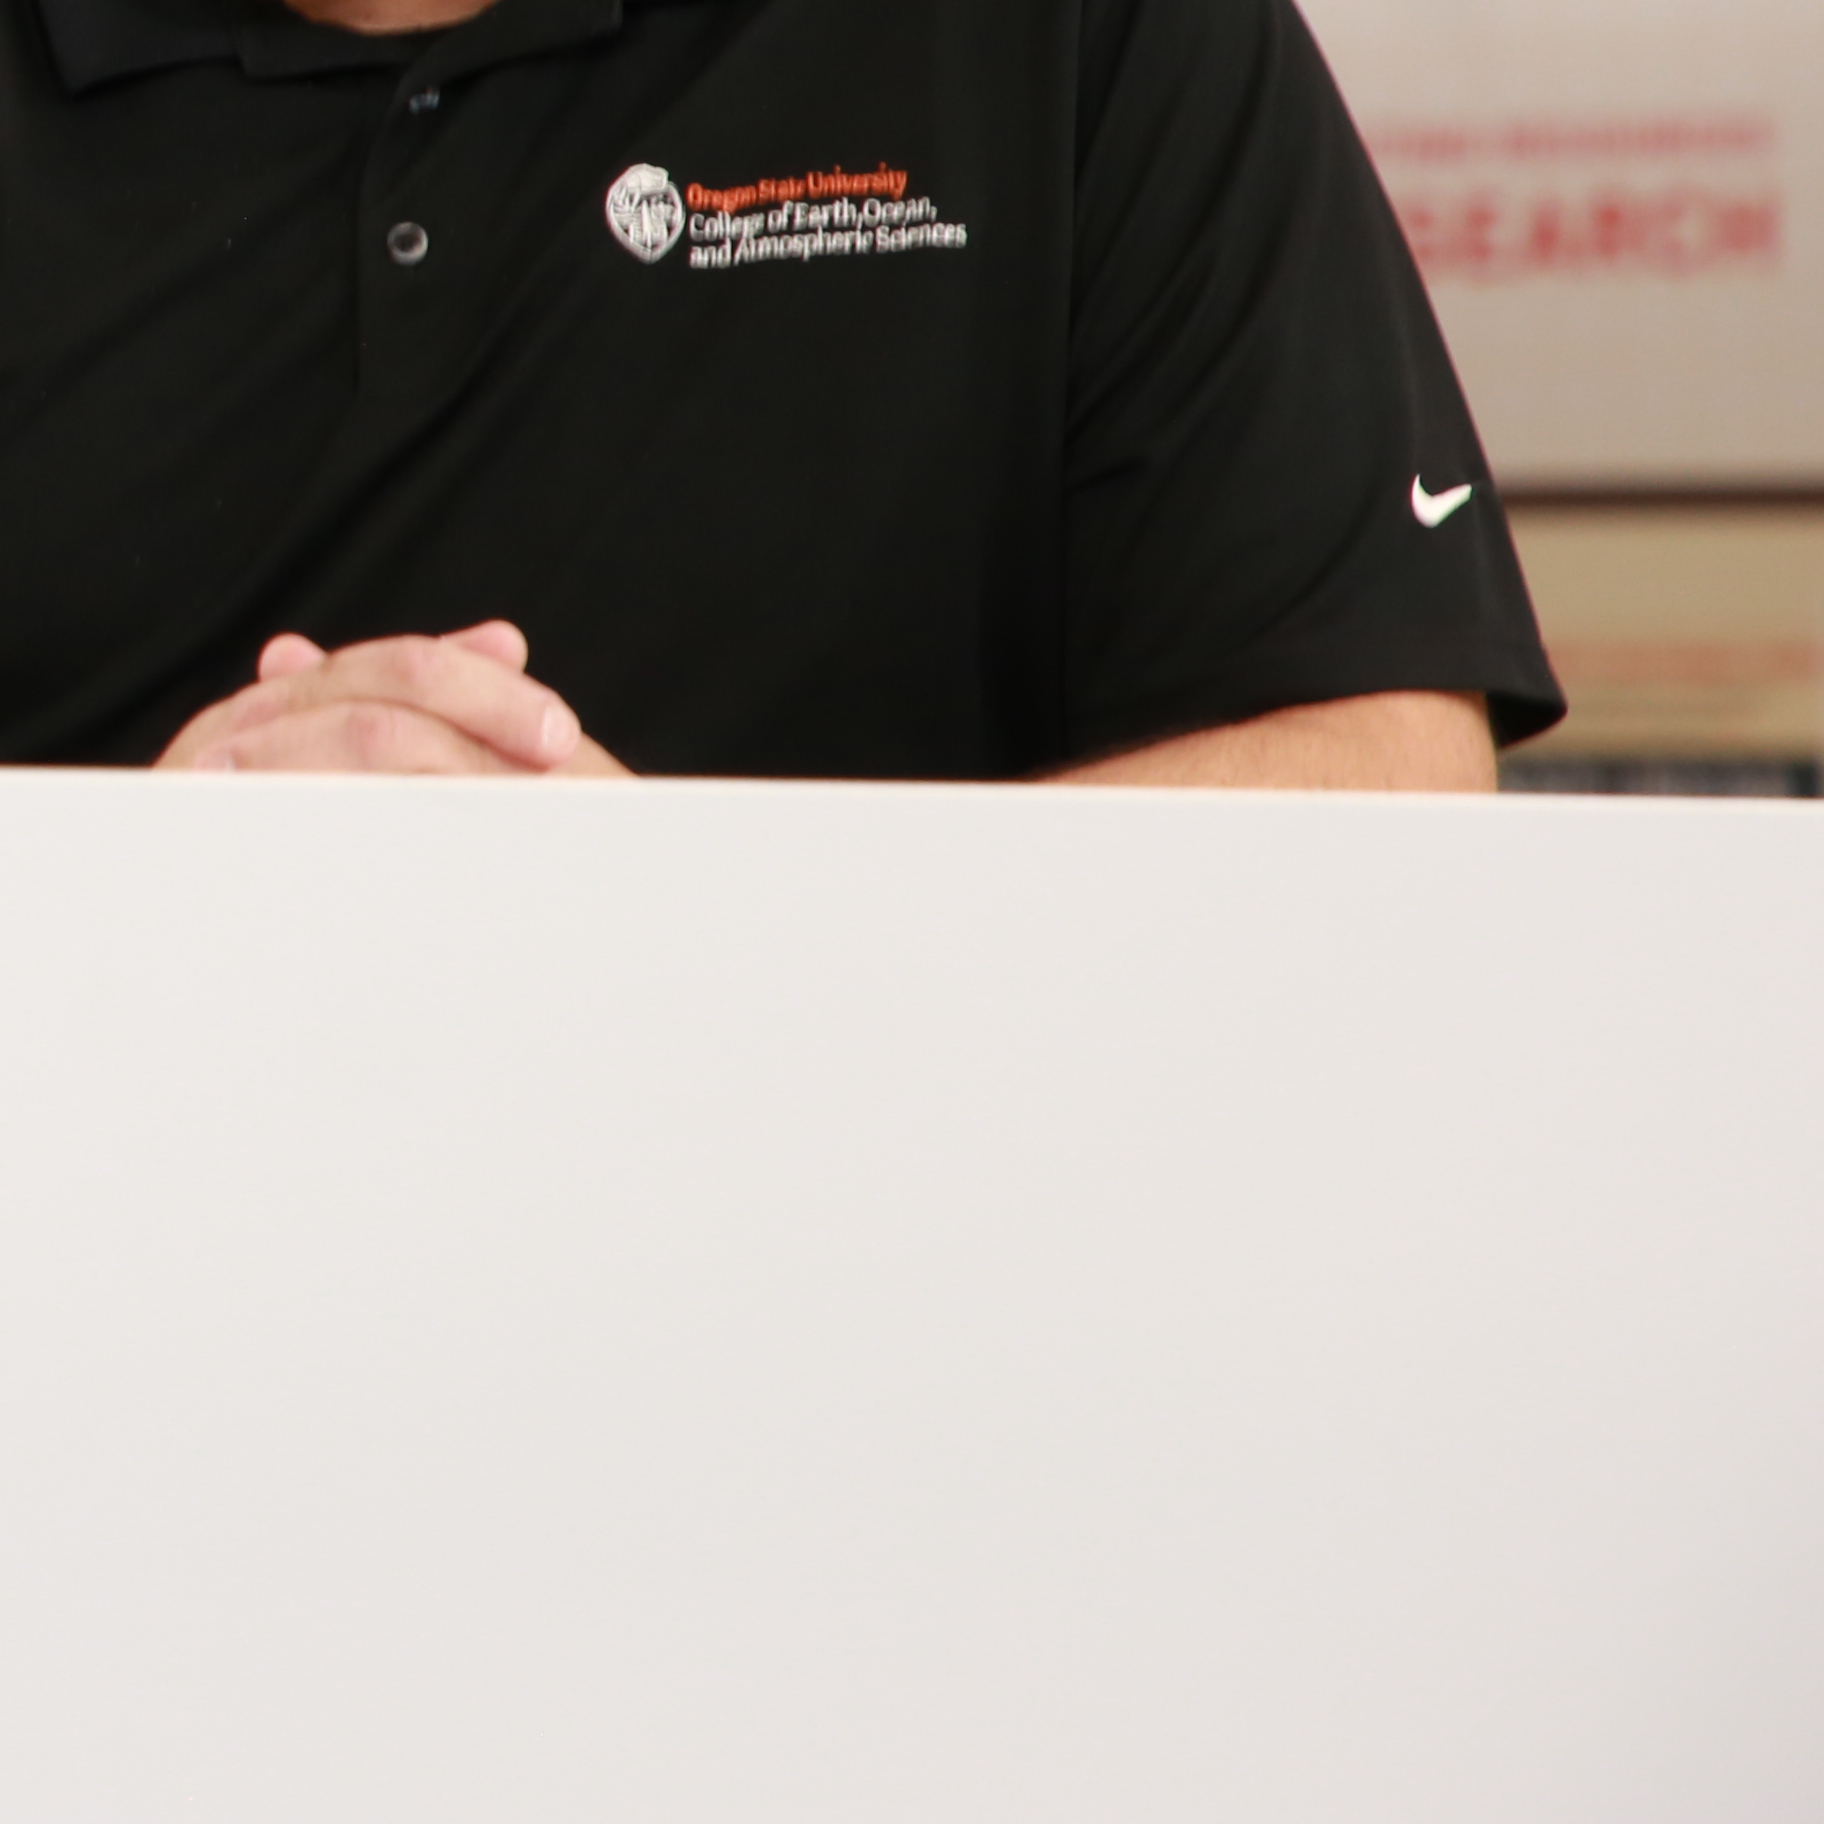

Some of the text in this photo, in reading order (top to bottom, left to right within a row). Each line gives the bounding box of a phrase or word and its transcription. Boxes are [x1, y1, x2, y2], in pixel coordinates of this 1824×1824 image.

[686, 161, 908, 214] Oregon State University
[689, 196, 938, 245] College of Earth, Ocean,
[689, 221, 967, 269] and Atmospheric Sciences
